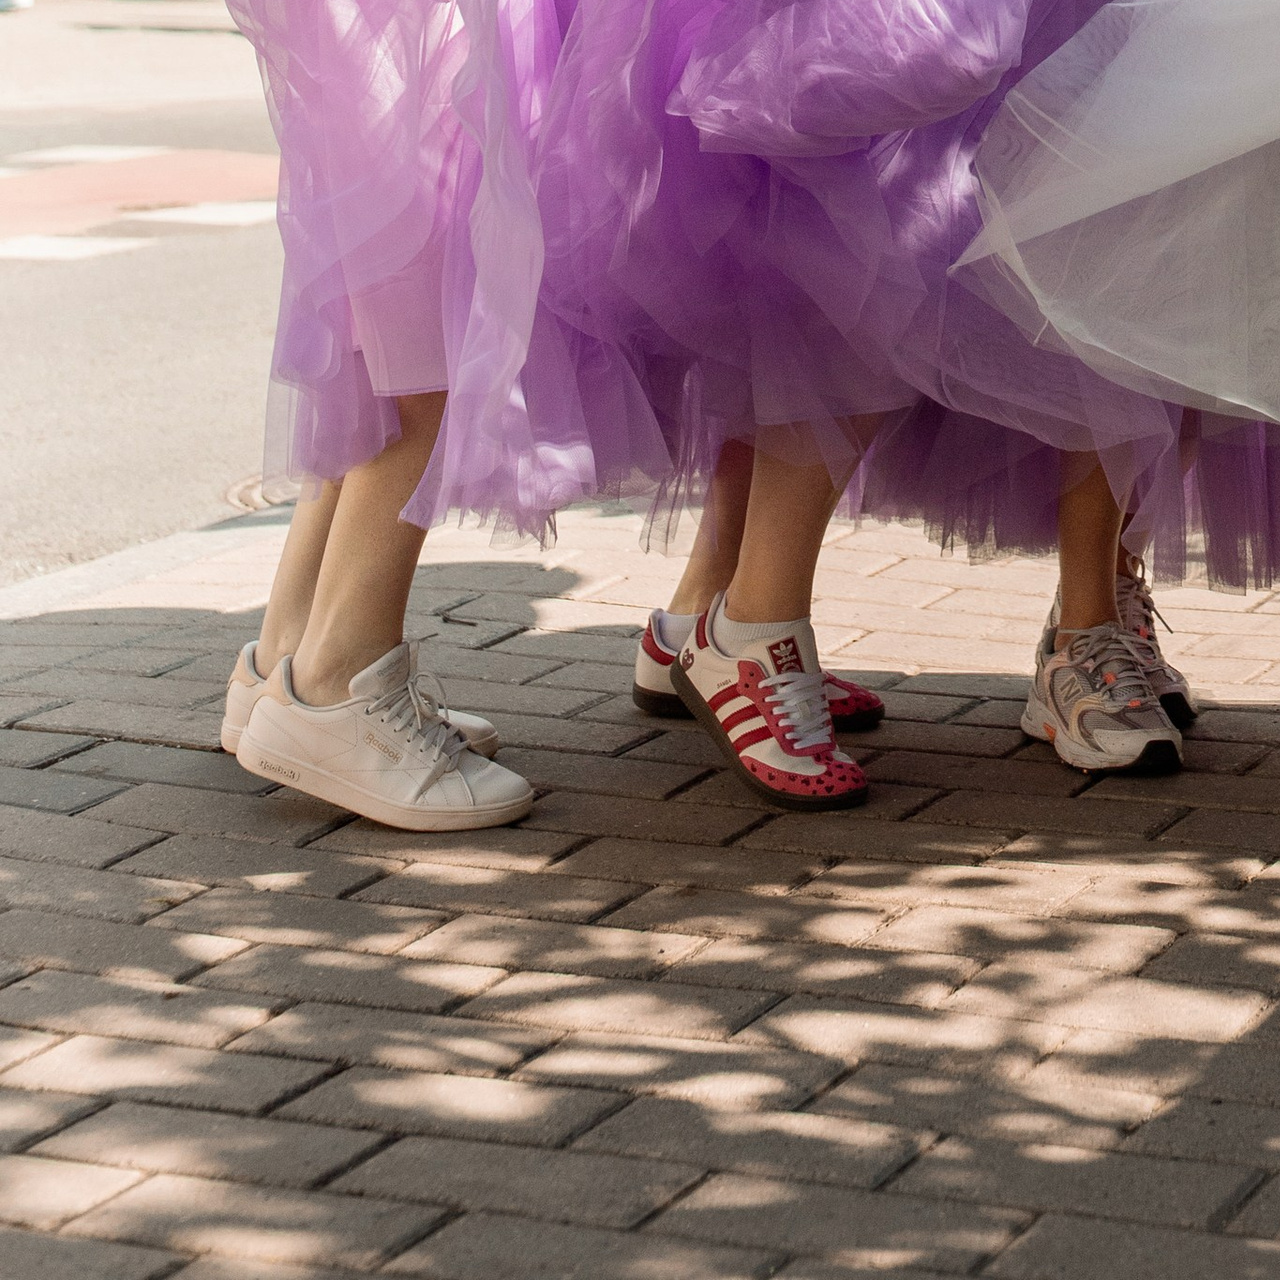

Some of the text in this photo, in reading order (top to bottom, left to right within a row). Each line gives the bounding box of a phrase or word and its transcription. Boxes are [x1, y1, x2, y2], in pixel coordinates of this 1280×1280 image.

[776, 654, 797, 665] adidas
[364, 732, 401, 763] Reebok
[259, 759, 297, 779] Reebok
